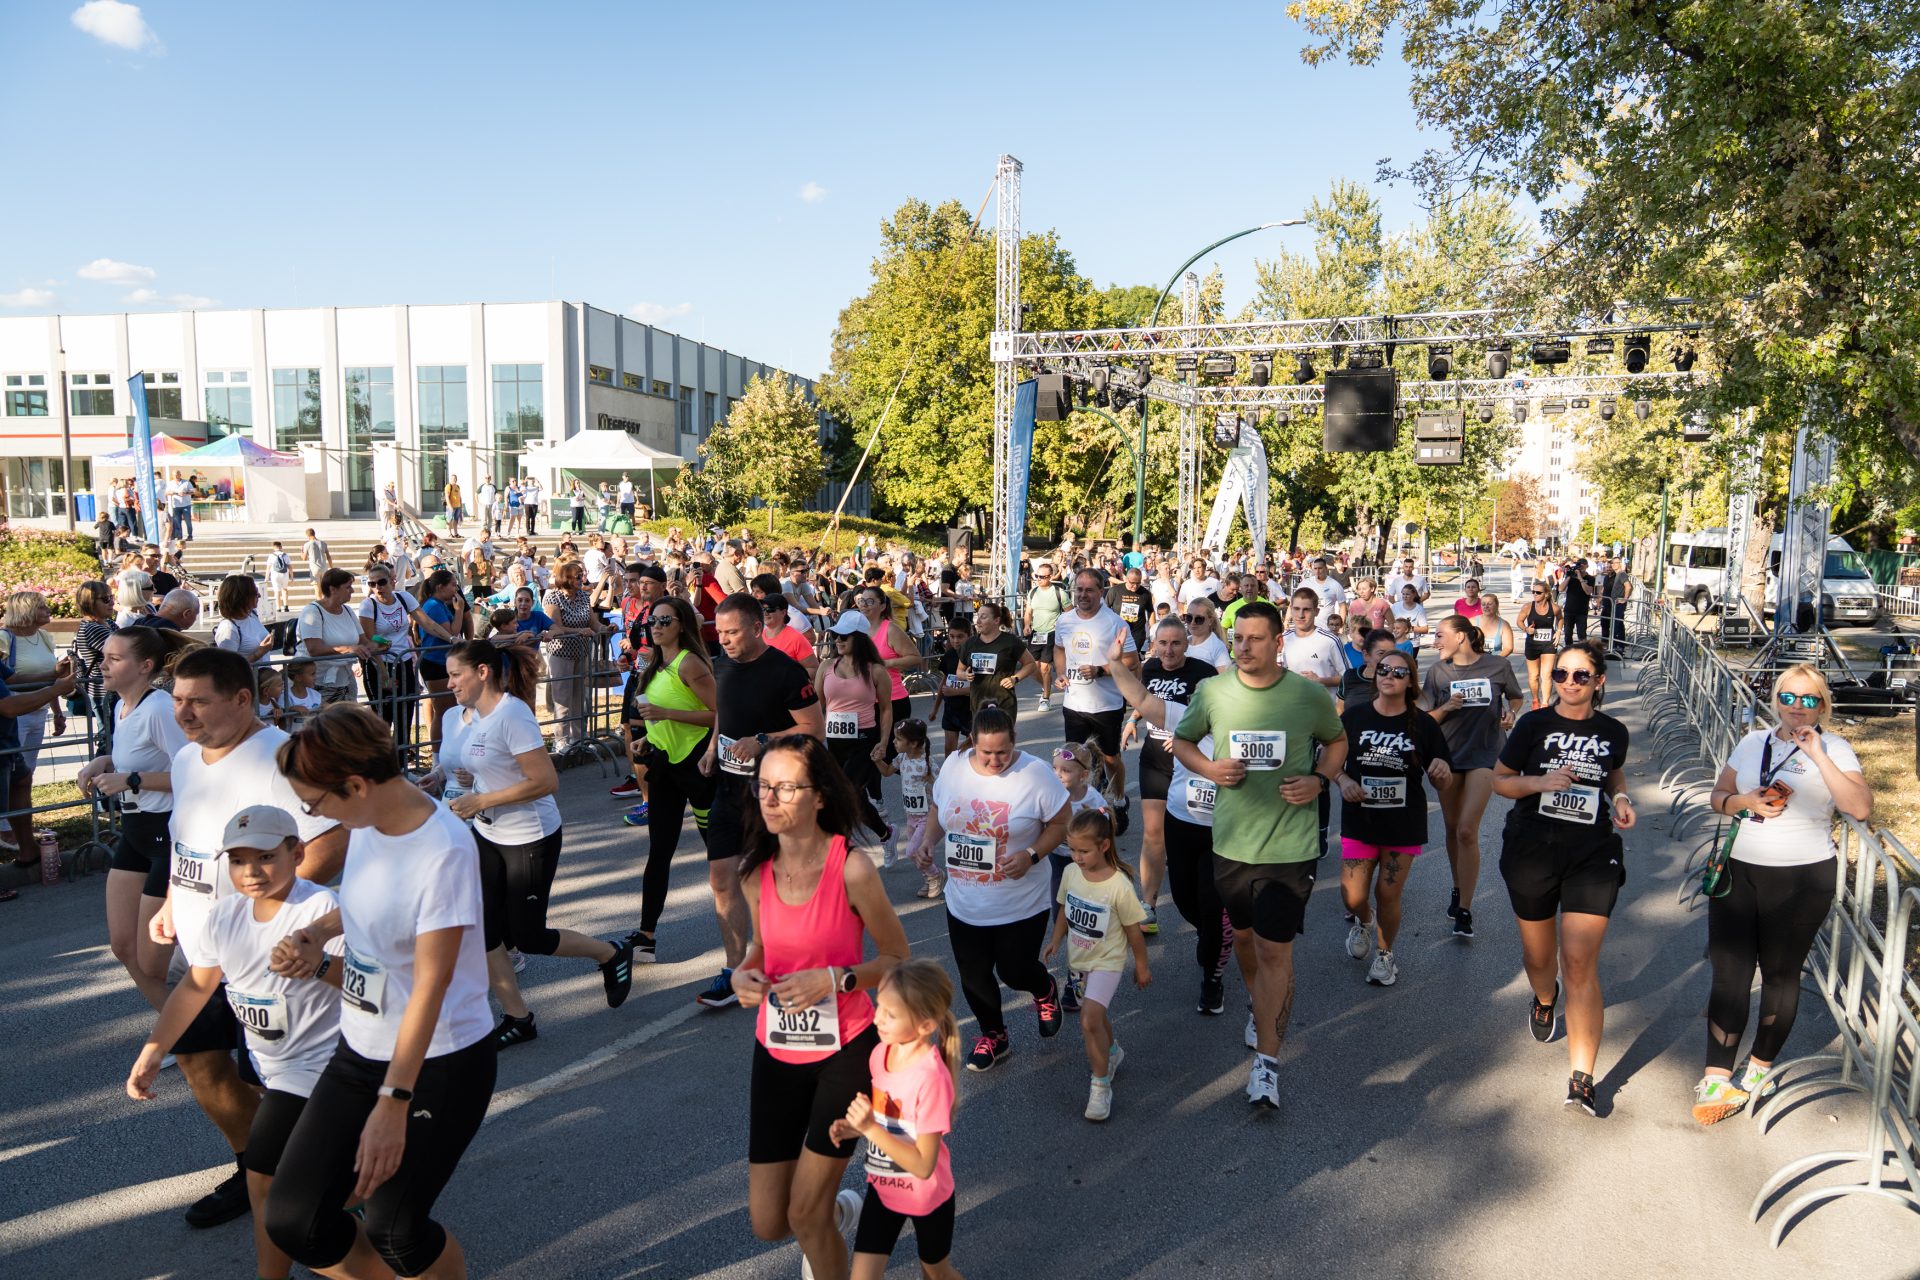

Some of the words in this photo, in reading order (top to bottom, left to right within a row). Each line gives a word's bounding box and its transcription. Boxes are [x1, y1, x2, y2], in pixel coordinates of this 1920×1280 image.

[1067, 669, 1083, 681] 873
[1147, 678, 1188, 695] FUTÁS
[827, 721, 856, 735] 8688
[1359, 730, 1416, 751] FUTÁS
[1543, 732, 1610, 756] FUTÁS
[1241, 743, 1274, 758] 3008
[1376, 746, 1393, 756] IGE
[1567, 750, 1589, 762] IGE
[1195, 788, 1214, 803] 315
[1371, 786, 1397, 799] 3193
[1552, 792, 1587, 811] 3002
[955, 844, 984, 861] 3010
[177, 857, 203, 880] 3201
[1070, 905, 1098, 929] 3009
[777, 1008, 821, 1032] 3032
[869, 1174, 915, 1192] YBARA
